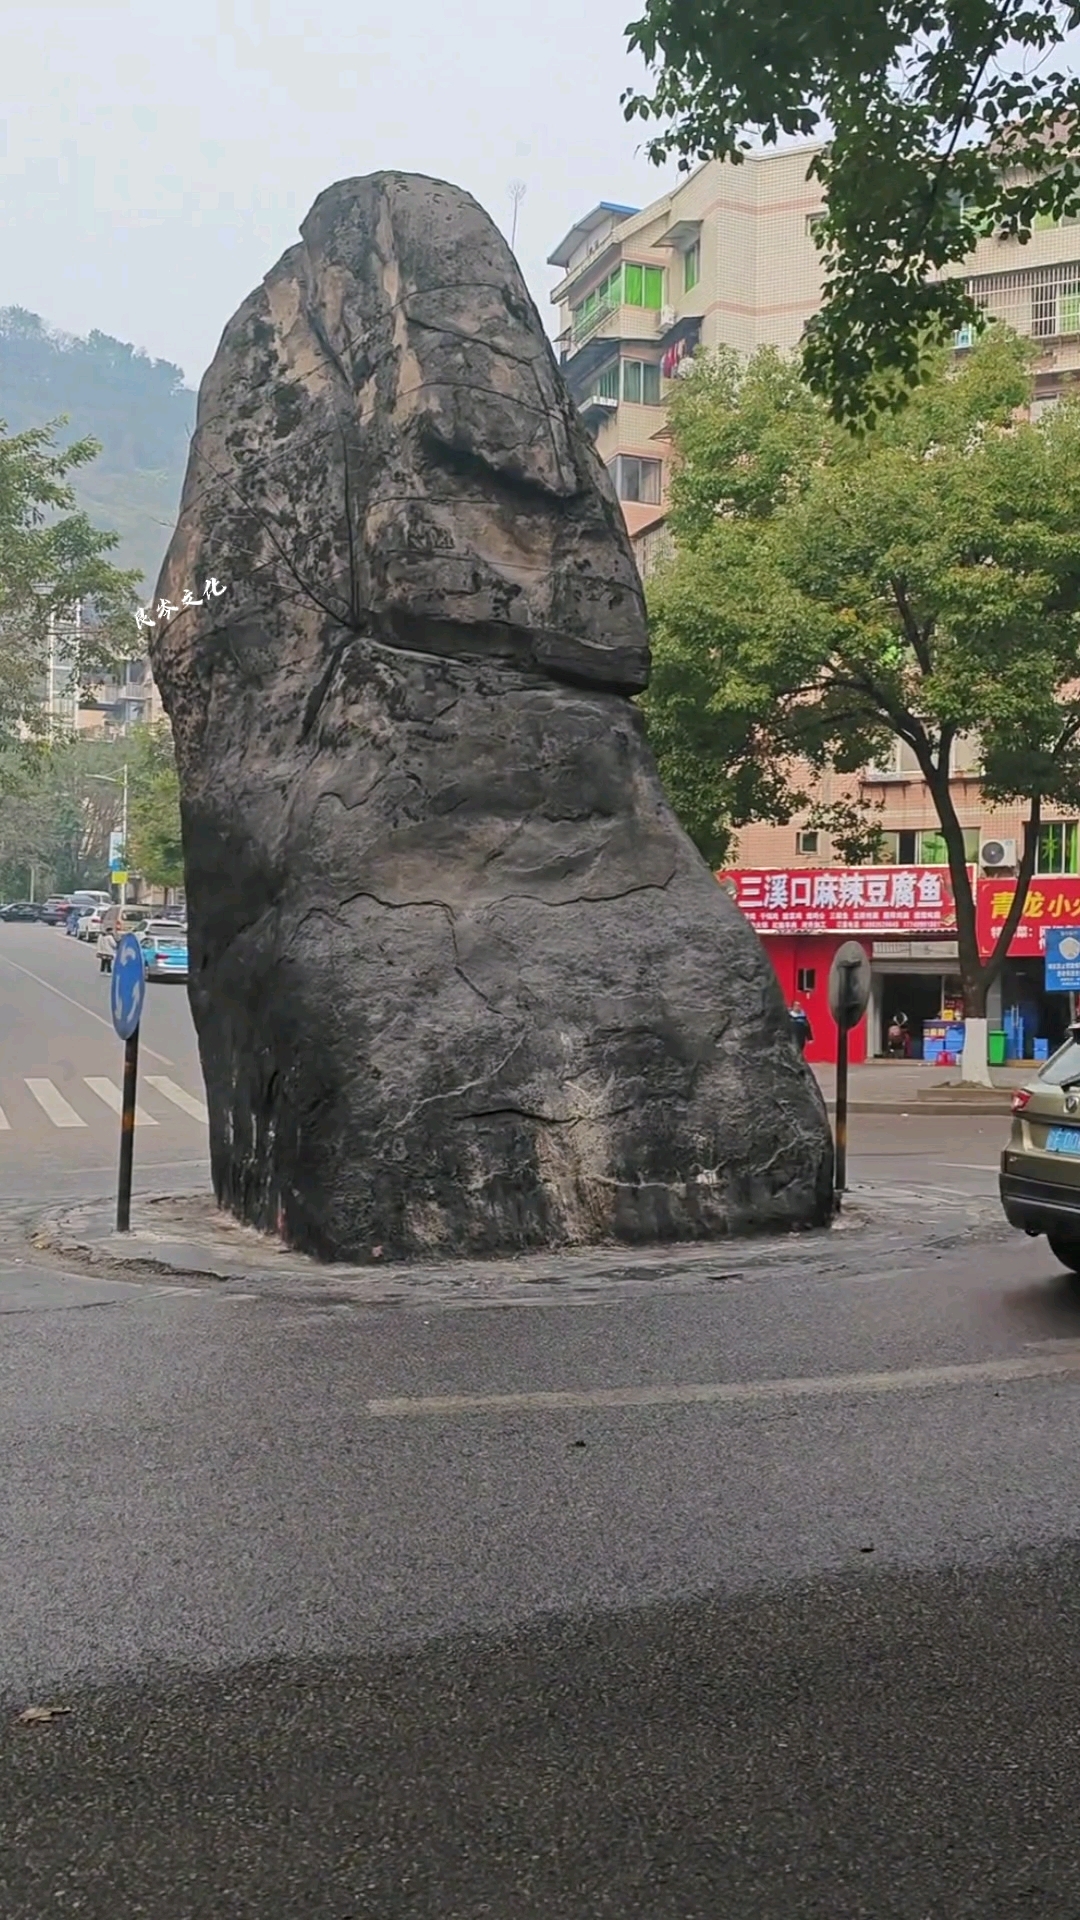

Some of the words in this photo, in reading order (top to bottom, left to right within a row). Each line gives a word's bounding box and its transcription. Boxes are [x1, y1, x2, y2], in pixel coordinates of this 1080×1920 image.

[738, 872, 943, 909] 三溪口麻辣豆腐鱼
